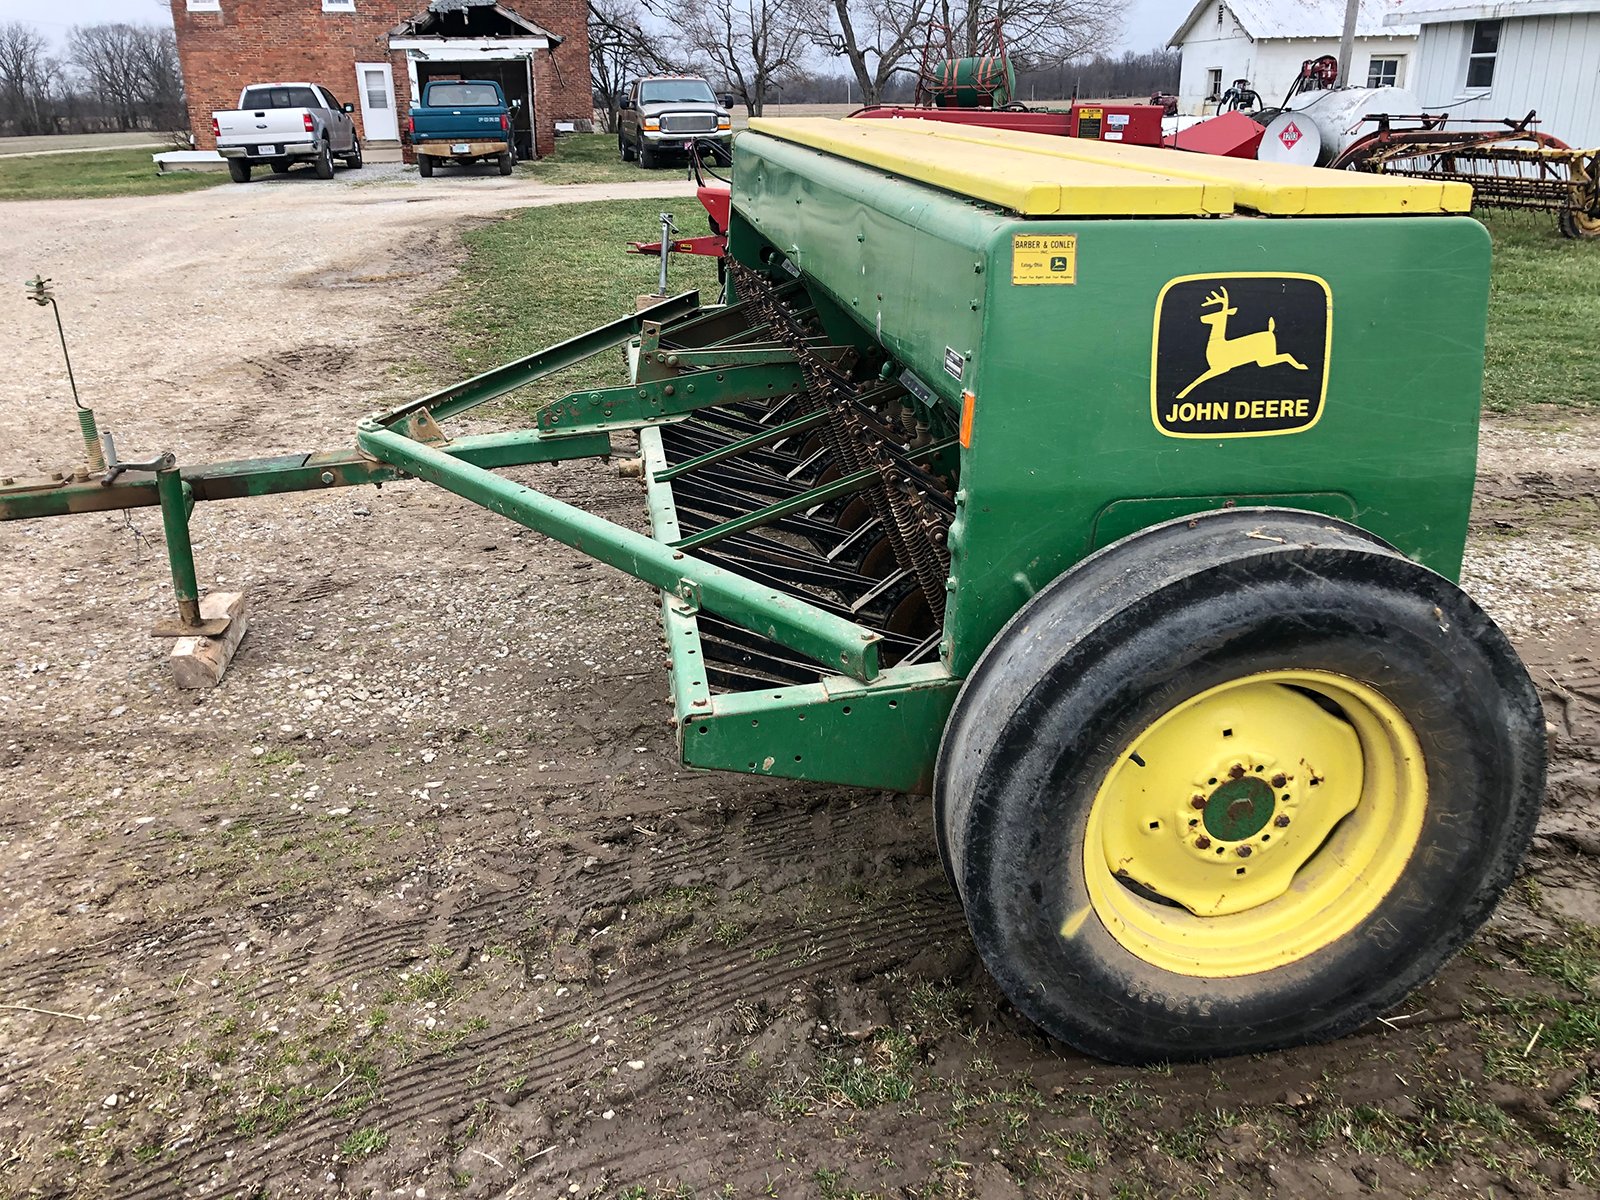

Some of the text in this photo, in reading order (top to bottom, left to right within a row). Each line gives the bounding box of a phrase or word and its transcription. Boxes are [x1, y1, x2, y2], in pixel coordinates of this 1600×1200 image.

[1284, 132, 1297, 140] 1203
[1050, 240, 1075, 248] CONLEY
[1165, 399, 1310, 423] JOHN DEERE
